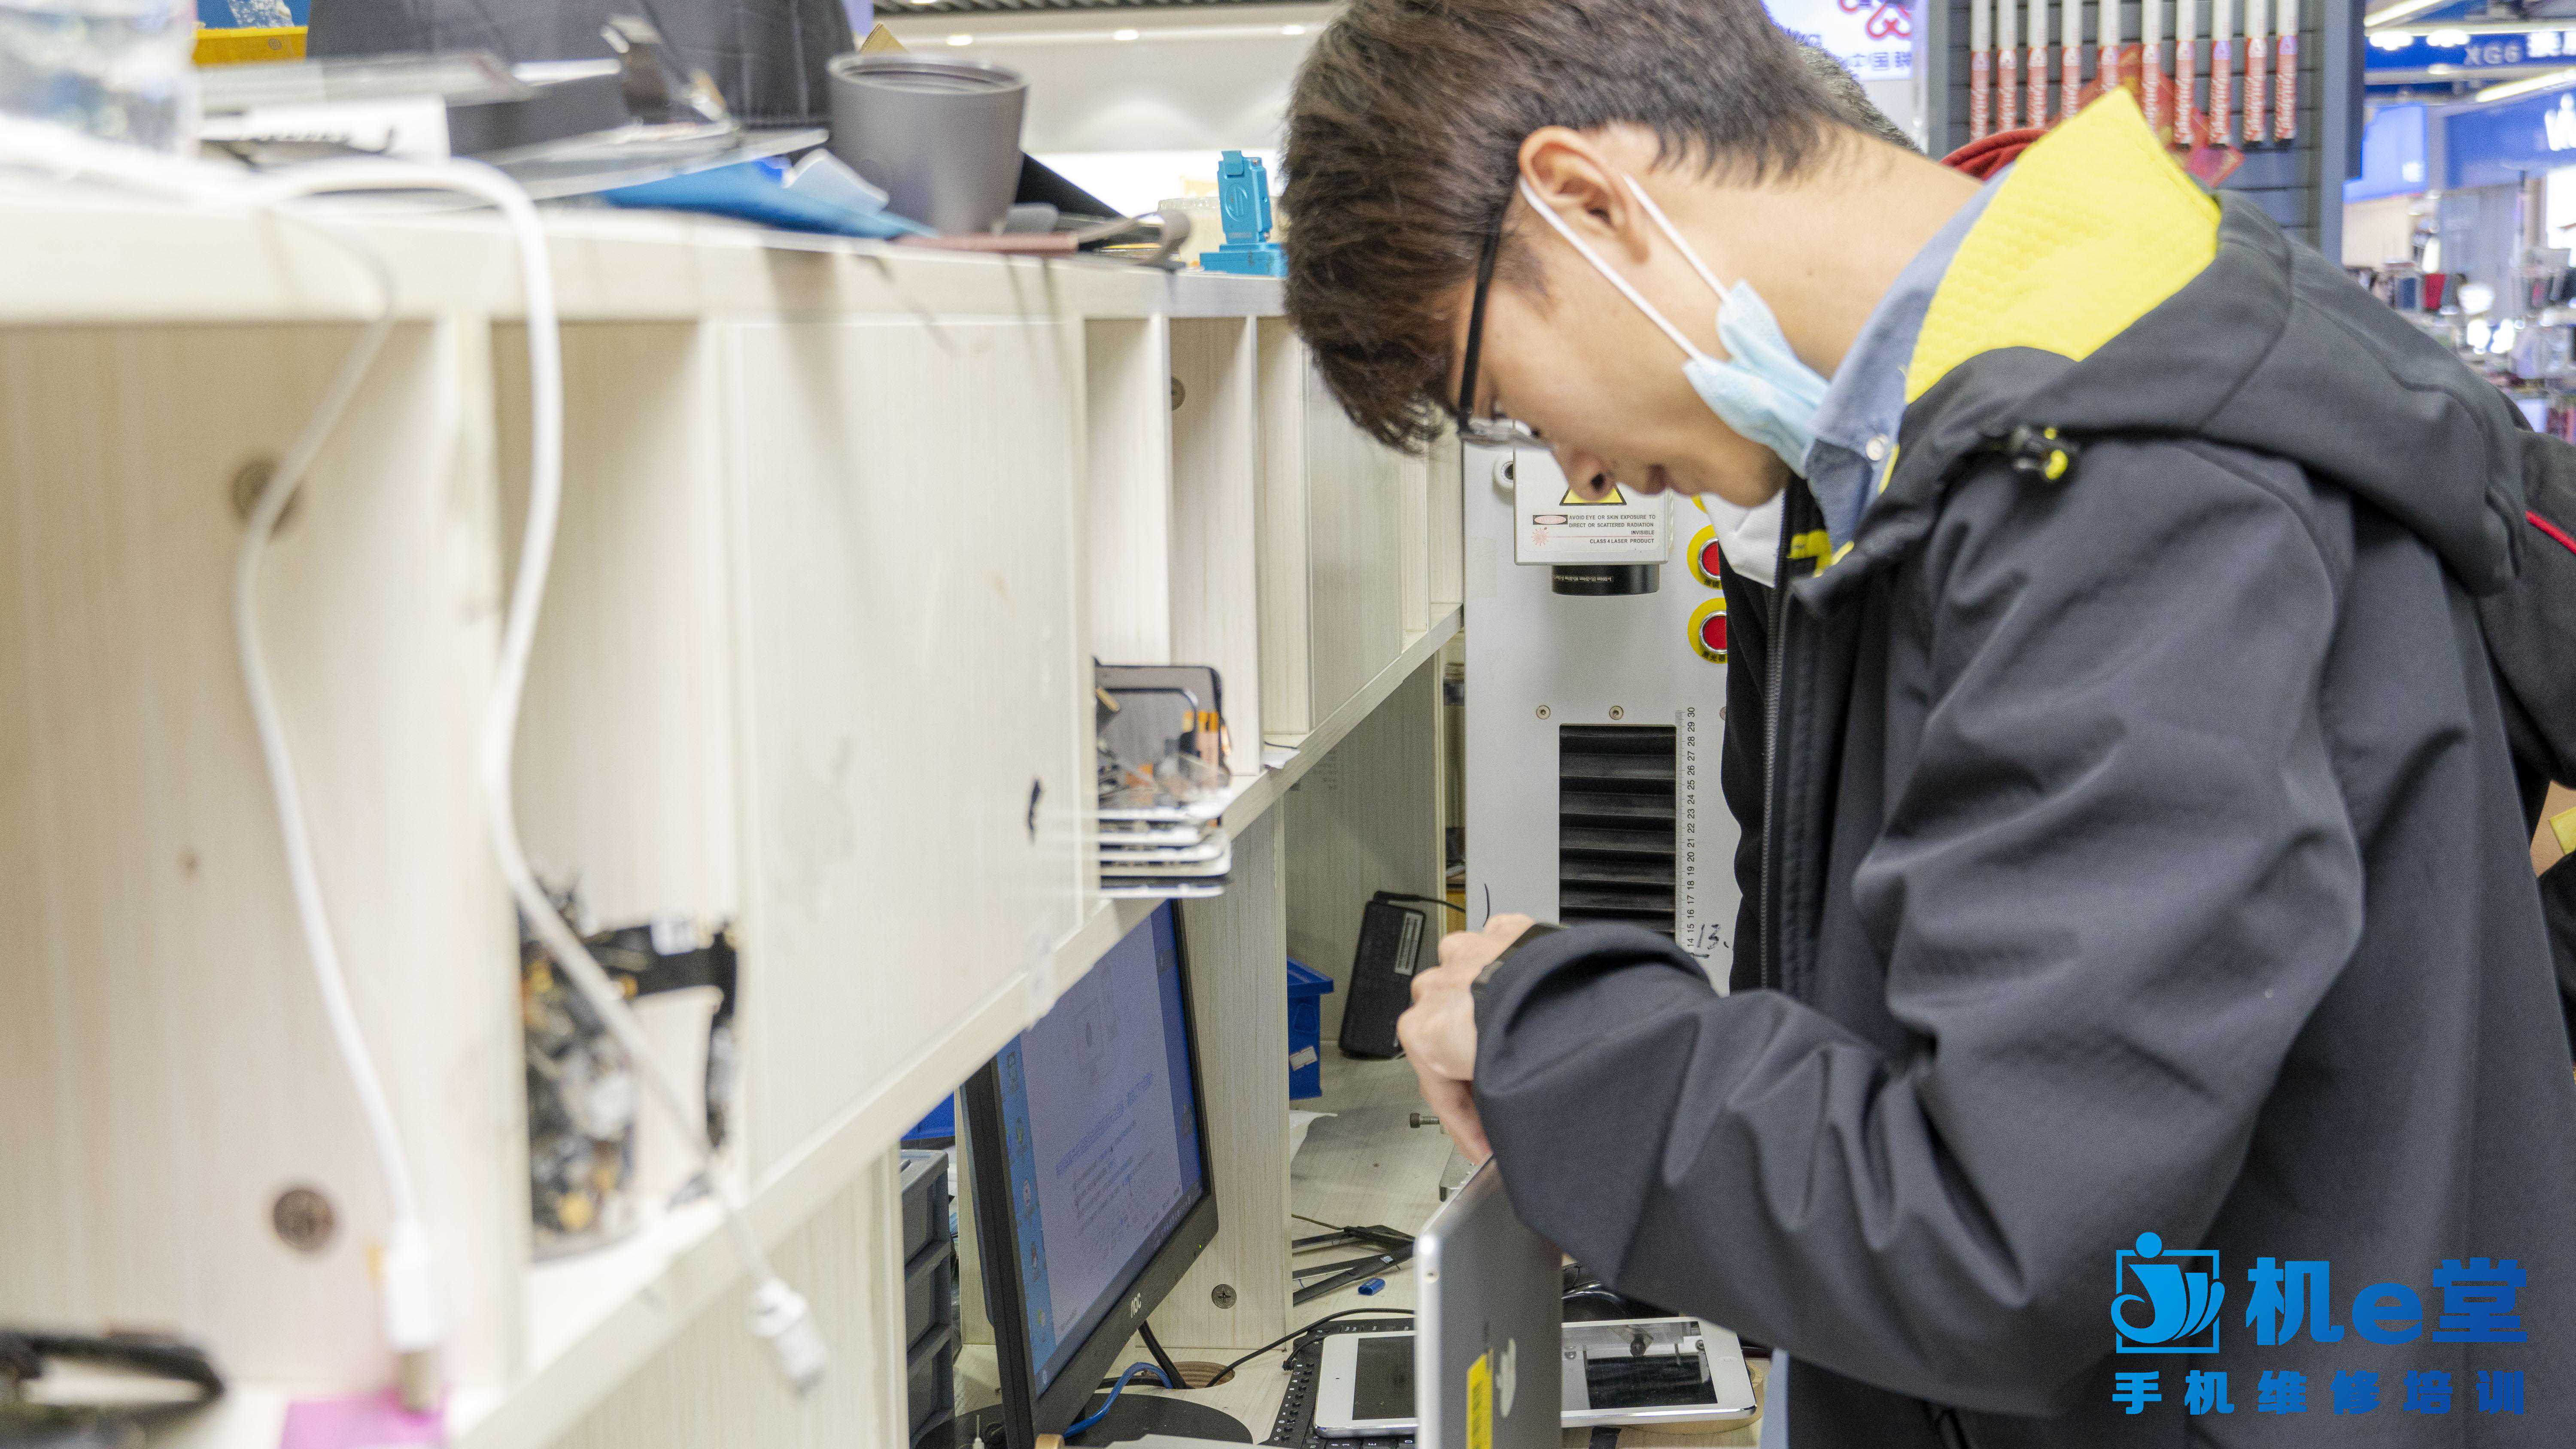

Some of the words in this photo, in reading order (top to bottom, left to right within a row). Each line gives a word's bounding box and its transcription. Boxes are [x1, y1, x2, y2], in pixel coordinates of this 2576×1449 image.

[1687, 707, 1695, 717] 30
[1687, 721, 1695, 732] 29
[1687, 736, 1695, 746] 28
[1687, 751, 1695, 761] 27
[1687, 765, 1695, 776] 26
[1687, 780, 1695, 790] 25
[1687, 794, 1695, 804] 24
[1687, 809, 1695, 819] 23
[1687, 823, 1695, 834] 22
[1687, 838, 1695, 848] 21
[1687, 852, 1695, 862] 20
[1687, 866, 1695, 876] 19
[1687, 880, 1695, 890] 18
[1687, 895, 1695, 904] 17
[1687, 909, 1695, 919] 16
[1687, 923, 1695, 933] 15
[1687, 938, 1695, 947] 14
[1131, 1292, 1142, 1319] AOC
